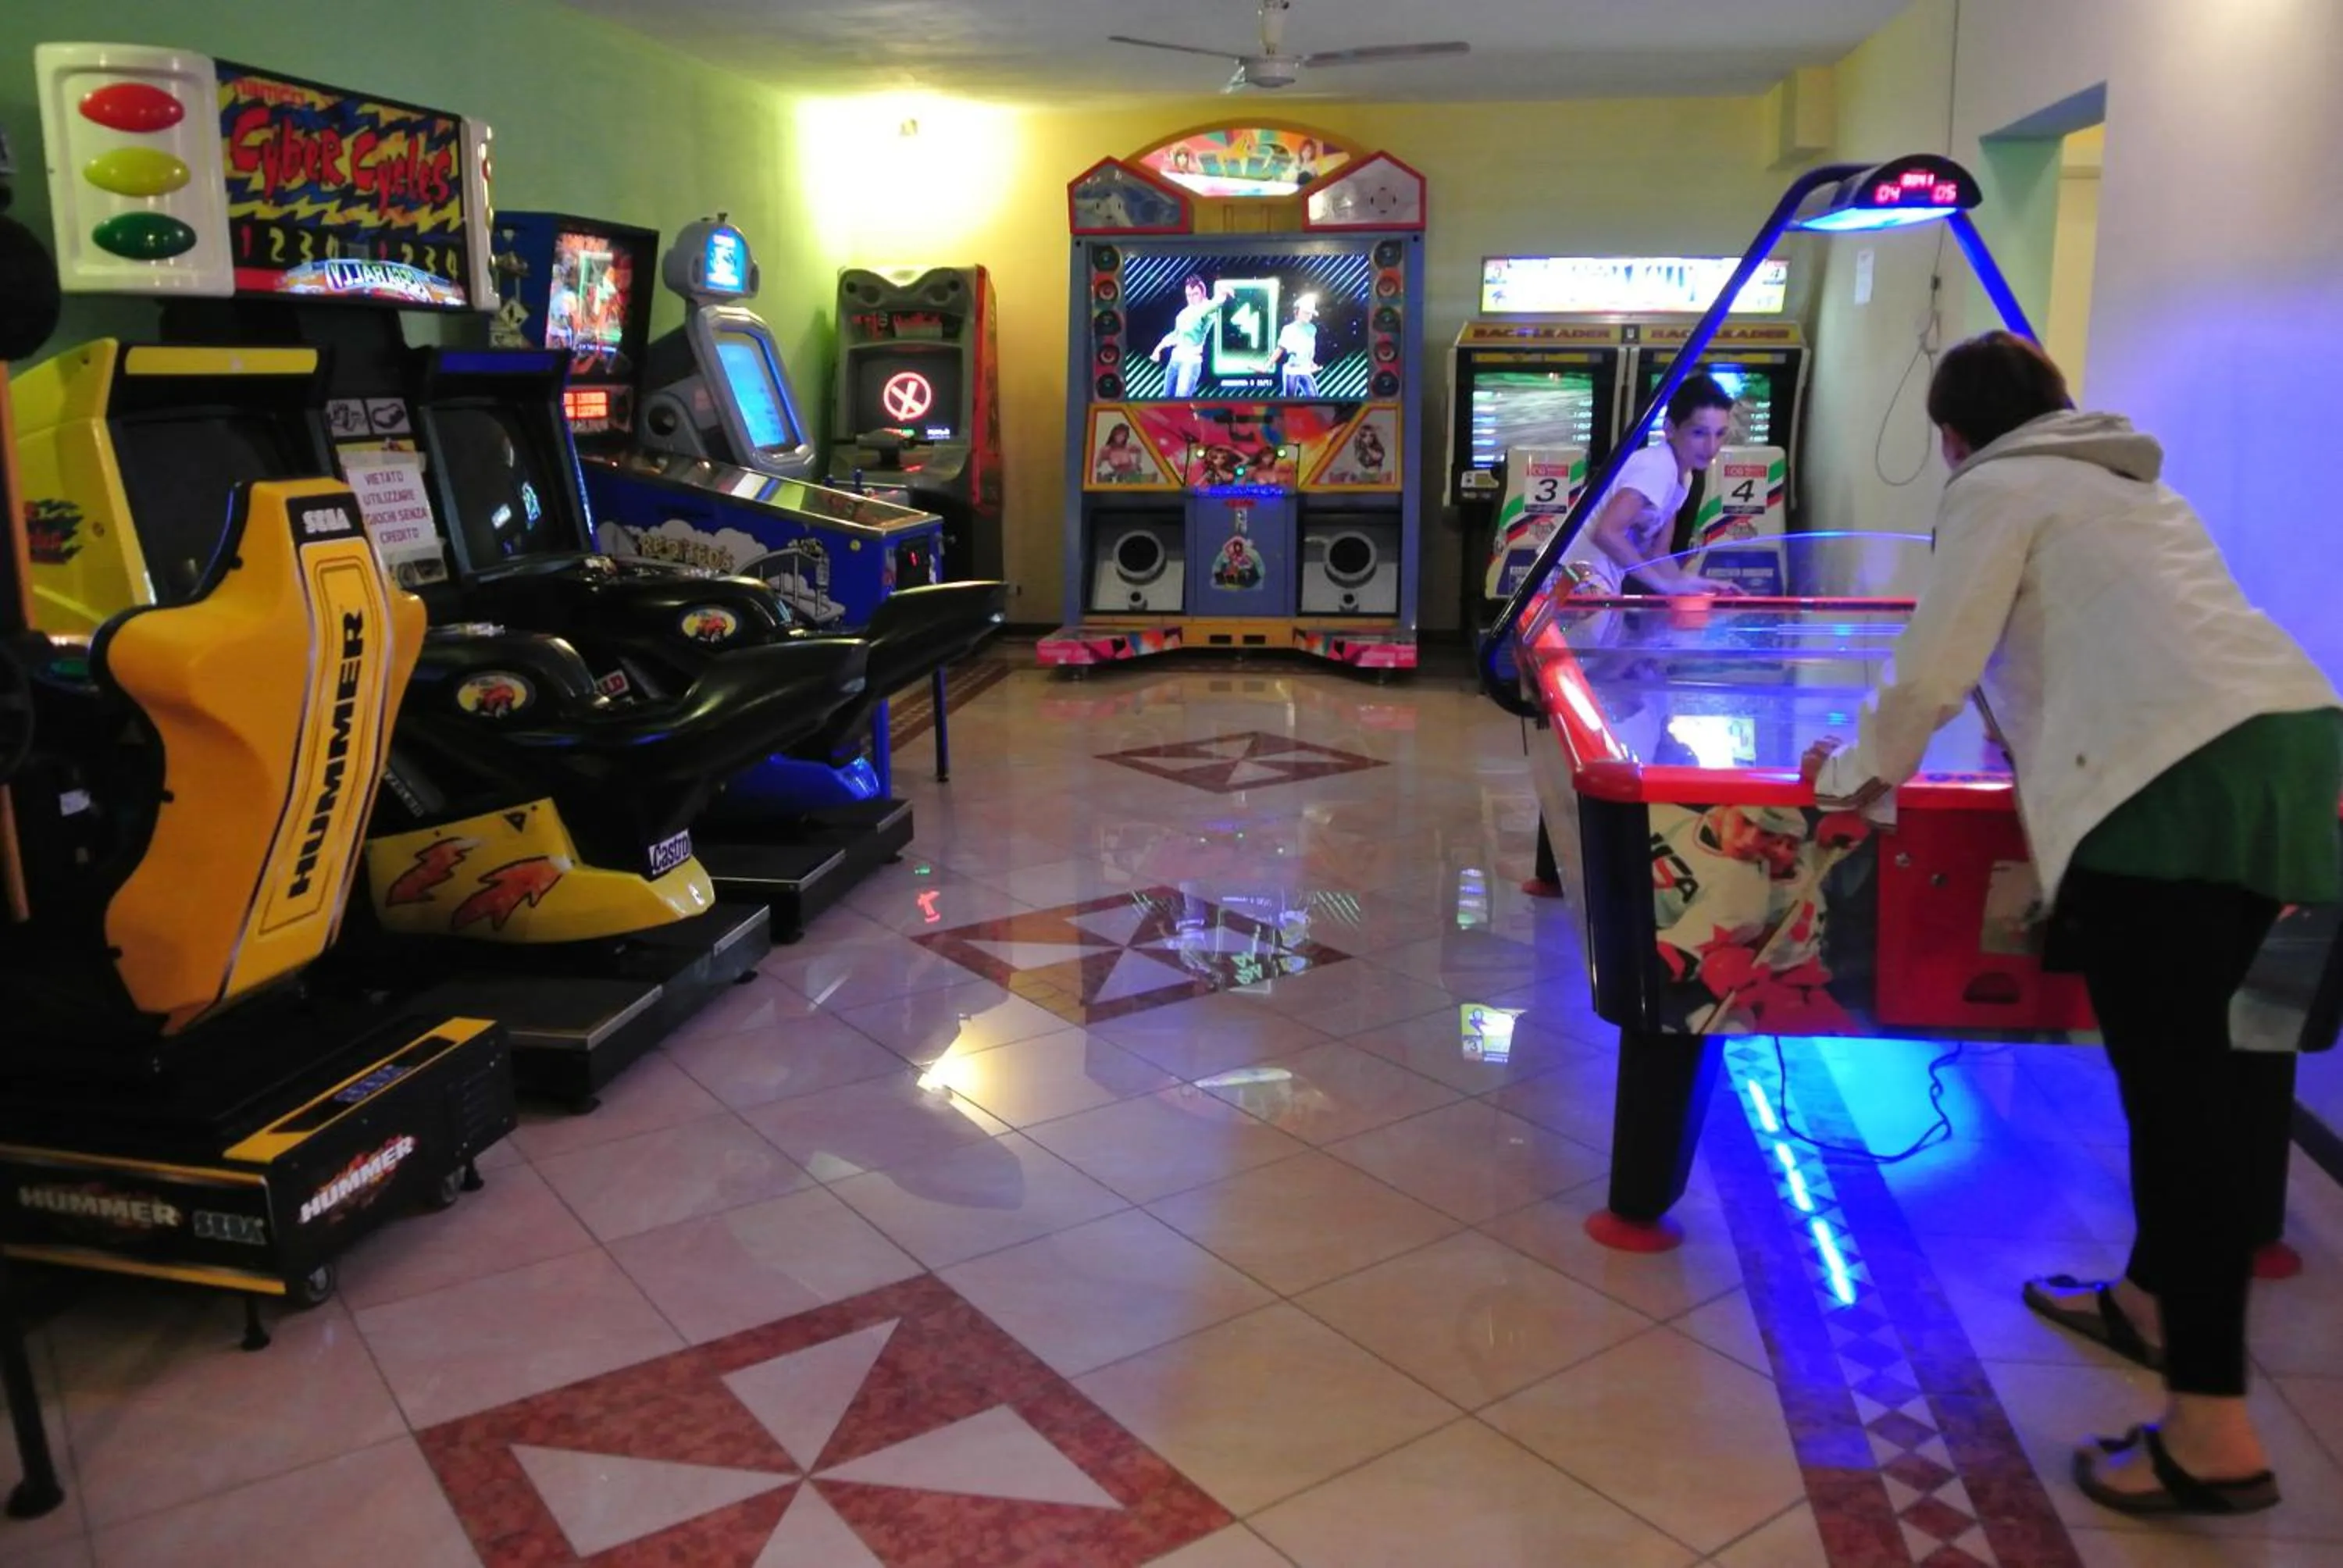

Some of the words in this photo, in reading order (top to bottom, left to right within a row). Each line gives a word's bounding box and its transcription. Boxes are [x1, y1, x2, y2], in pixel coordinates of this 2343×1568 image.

[364, 471, 404, 486] VIETATO
[1535, 479, 1558, 502] 3
[362, 489, 416, 505] UTILIZZARE
[1731, 479, 1754, 503] 4
[301, 508, 351, 533] SEGA
[398, 508, 427, 521] SENZA
[380, 527, 419, 544] CREDITO
[287, 608, 364, 899] HUMMER
[298, 1136, 414, 1224] HUMMER
[17, 1185, 180, 1228] HUMMER
[193, 1208, 268, 1246] SEGA
